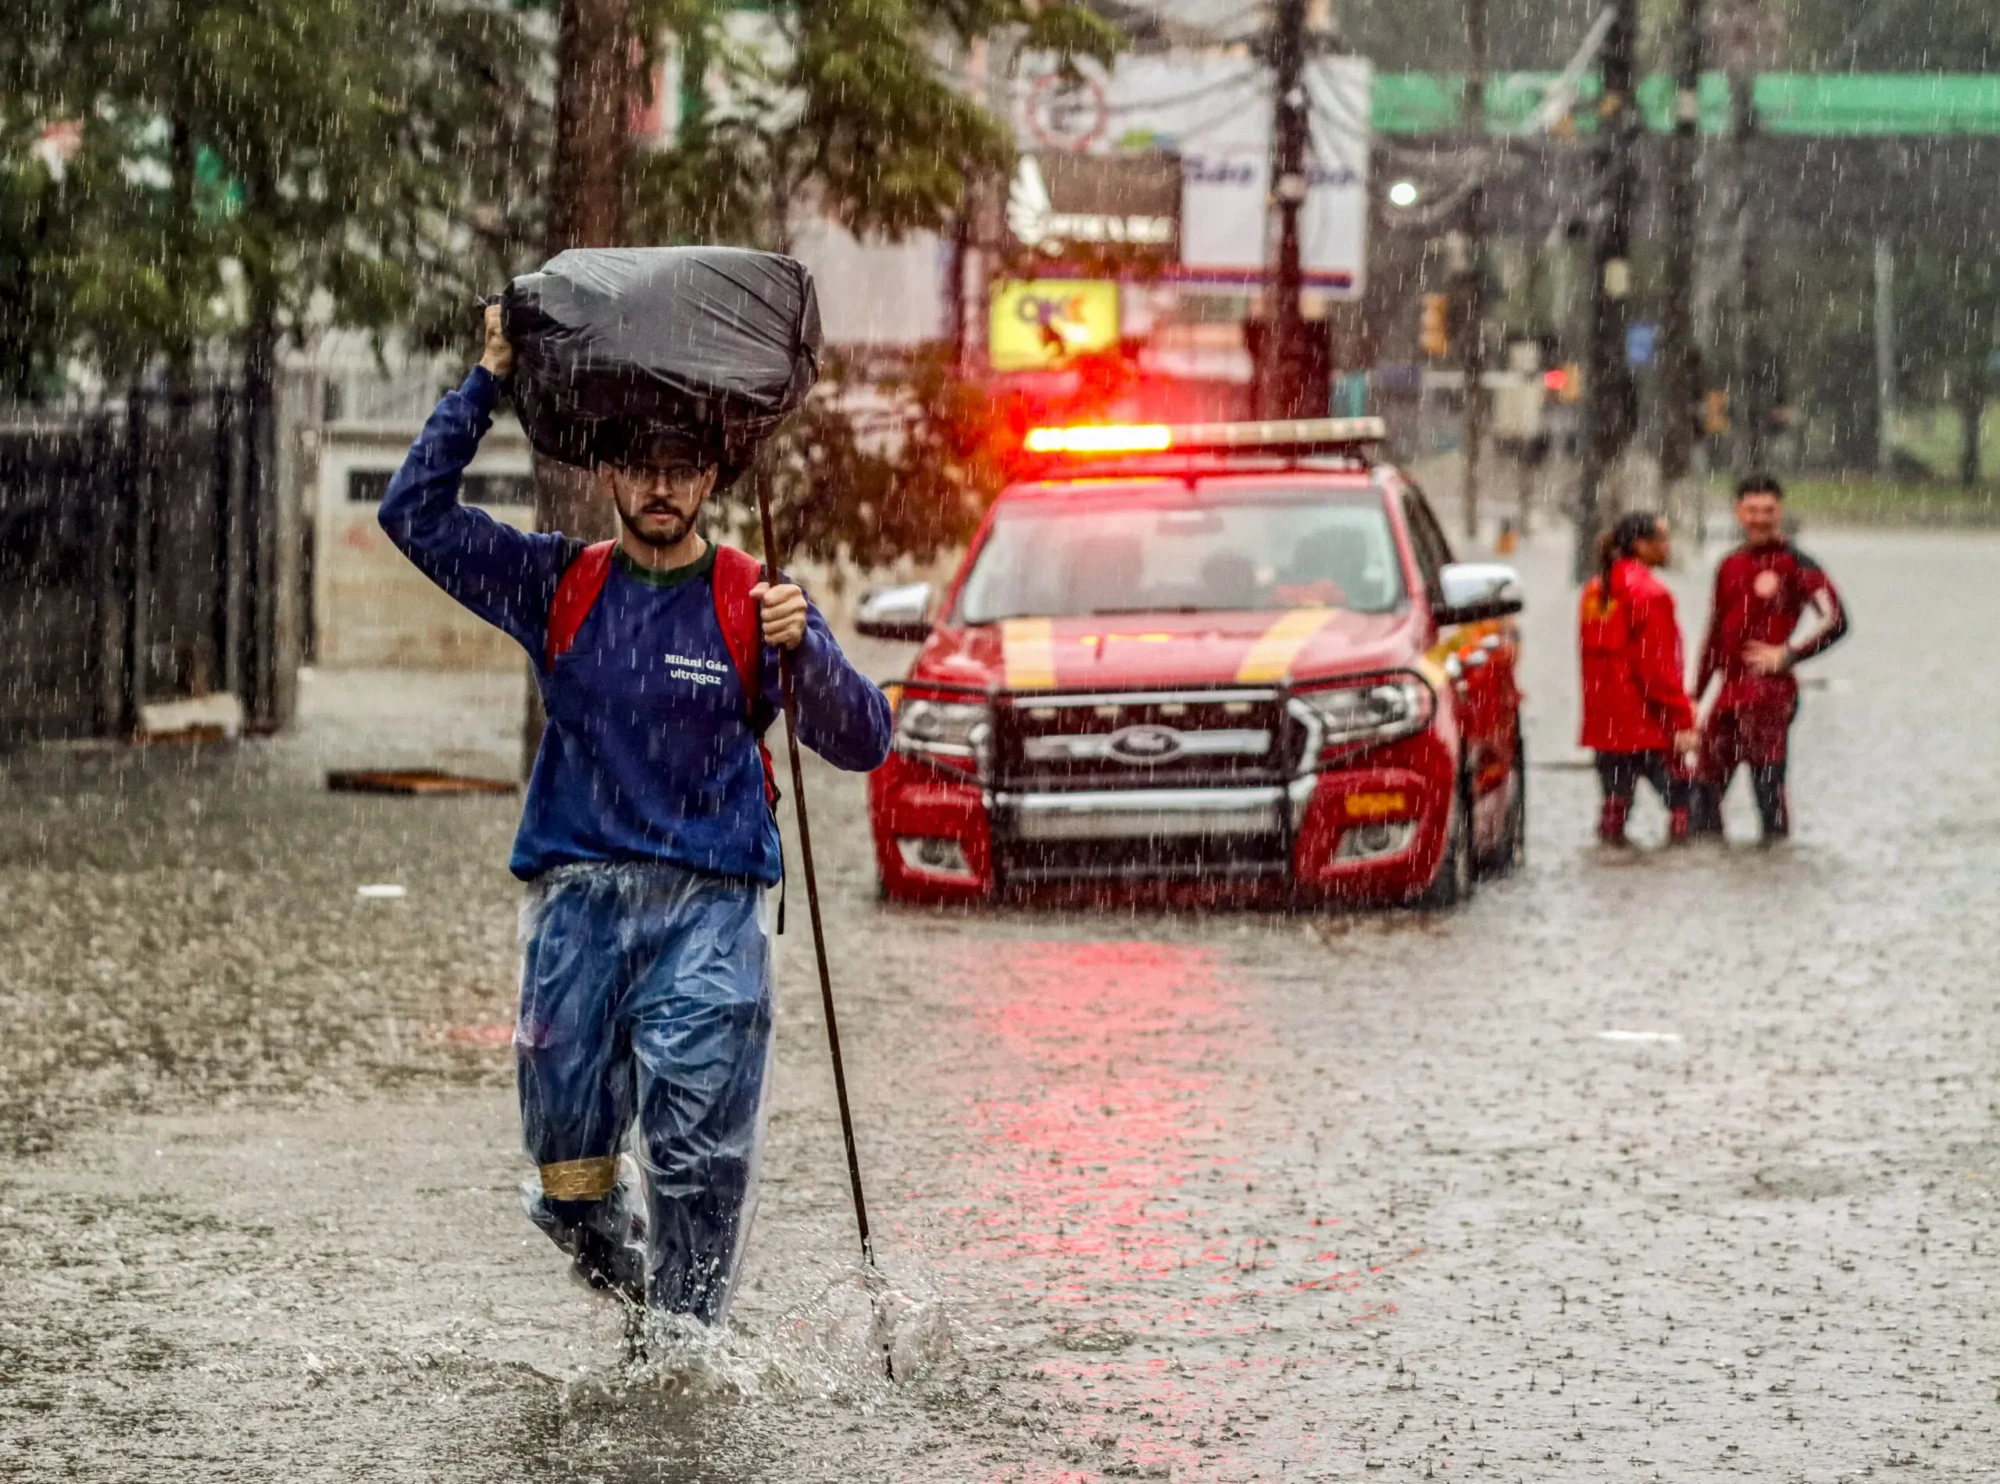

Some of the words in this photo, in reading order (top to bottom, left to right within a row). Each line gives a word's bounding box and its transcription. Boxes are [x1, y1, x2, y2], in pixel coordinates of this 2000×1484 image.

[664, 653, 702, 668] Milani
[705, 659, 729, 673] Gás
[670, 668, 722, 685] ultragaz
